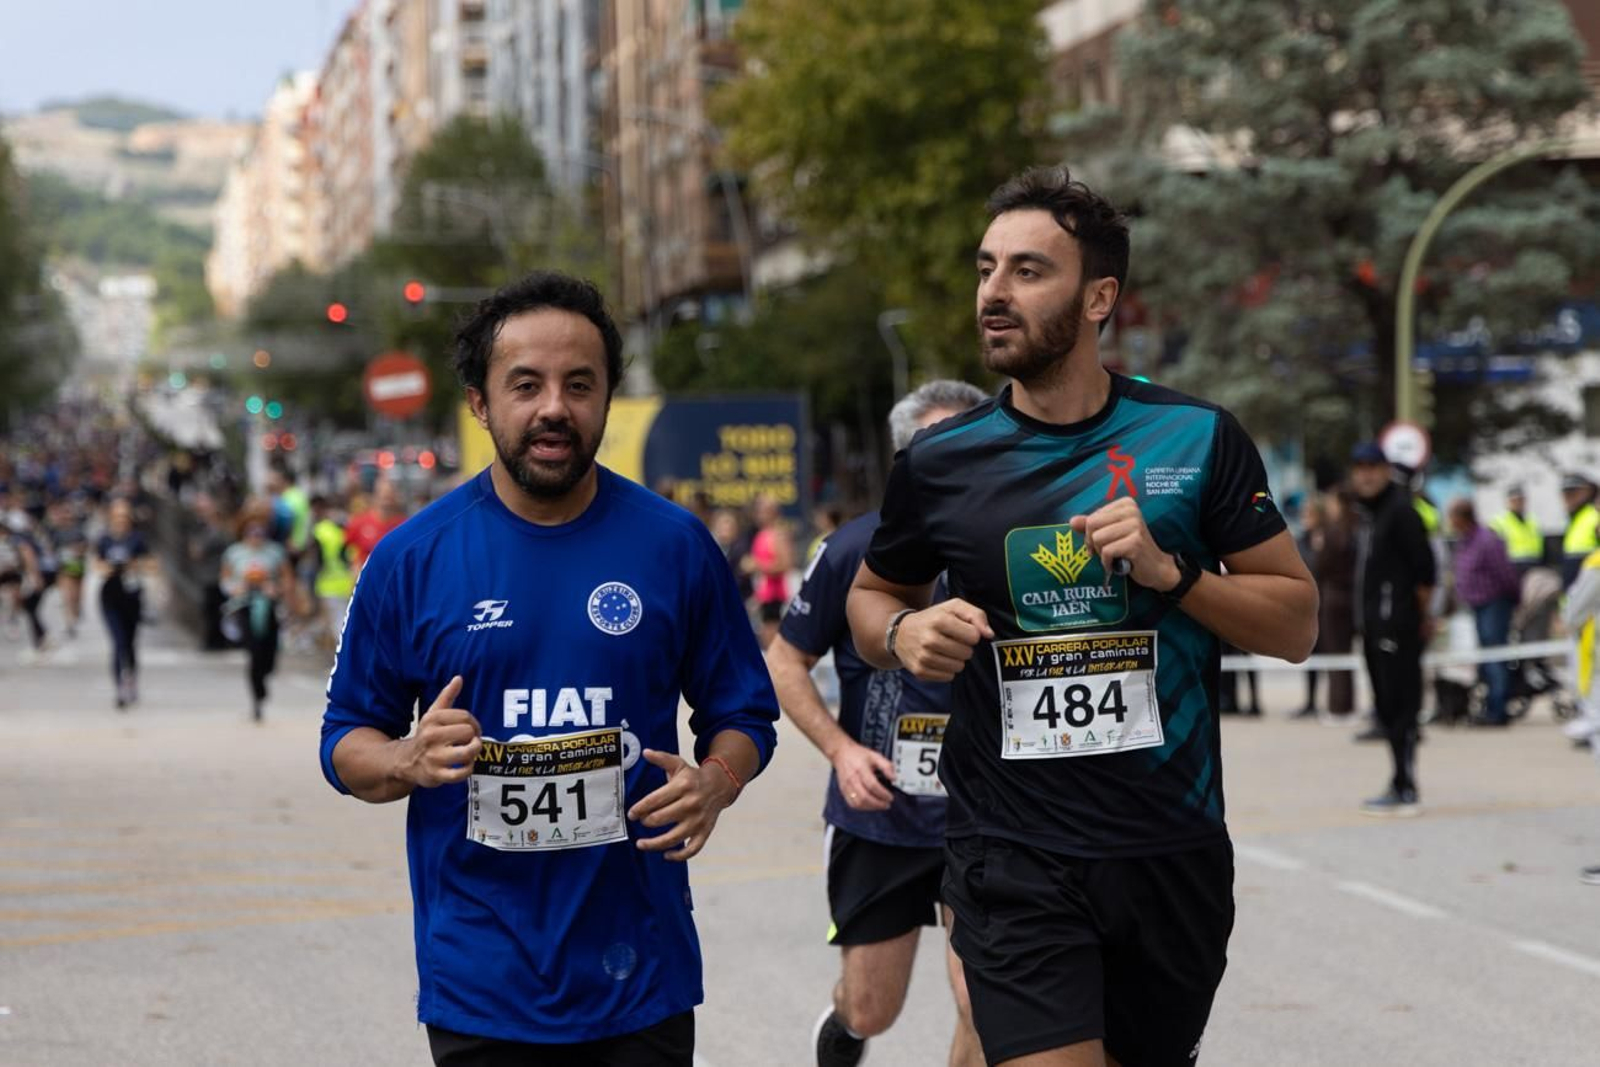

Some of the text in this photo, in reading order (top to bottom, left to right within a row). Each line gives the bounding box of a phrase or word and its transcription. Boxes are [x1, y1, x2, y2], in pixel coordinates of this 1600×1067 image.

[720, 425, 796, 449] TODO
[1022, 585, 1118, 606] CAJA RURAL
[1052, 600, 1091, 617] JAÉN
[467, 620, 513, 632] TOPPER
[1003, 637, 1149, 667] XXV CARRERA POPULAR
[1036, 646, 1149, 666] y gran caminata
[1036, 667, 1047, 677] LA
[1073, 664, 1086, 675] LA
[503, 687, 613, 728] FIAT
[1033, 680, 1128, 729] 484
[507, 743, 560, 753] CARRERA
[562, 734, 616, 750] POPULAR
[506, 744, 617, 764] y gran caminata
[917, 748, 937, 776] 5
[504, 765, 517, 775] LA
[542, 764, 556, 775] LA
[500, 778, 587, 826] 541
